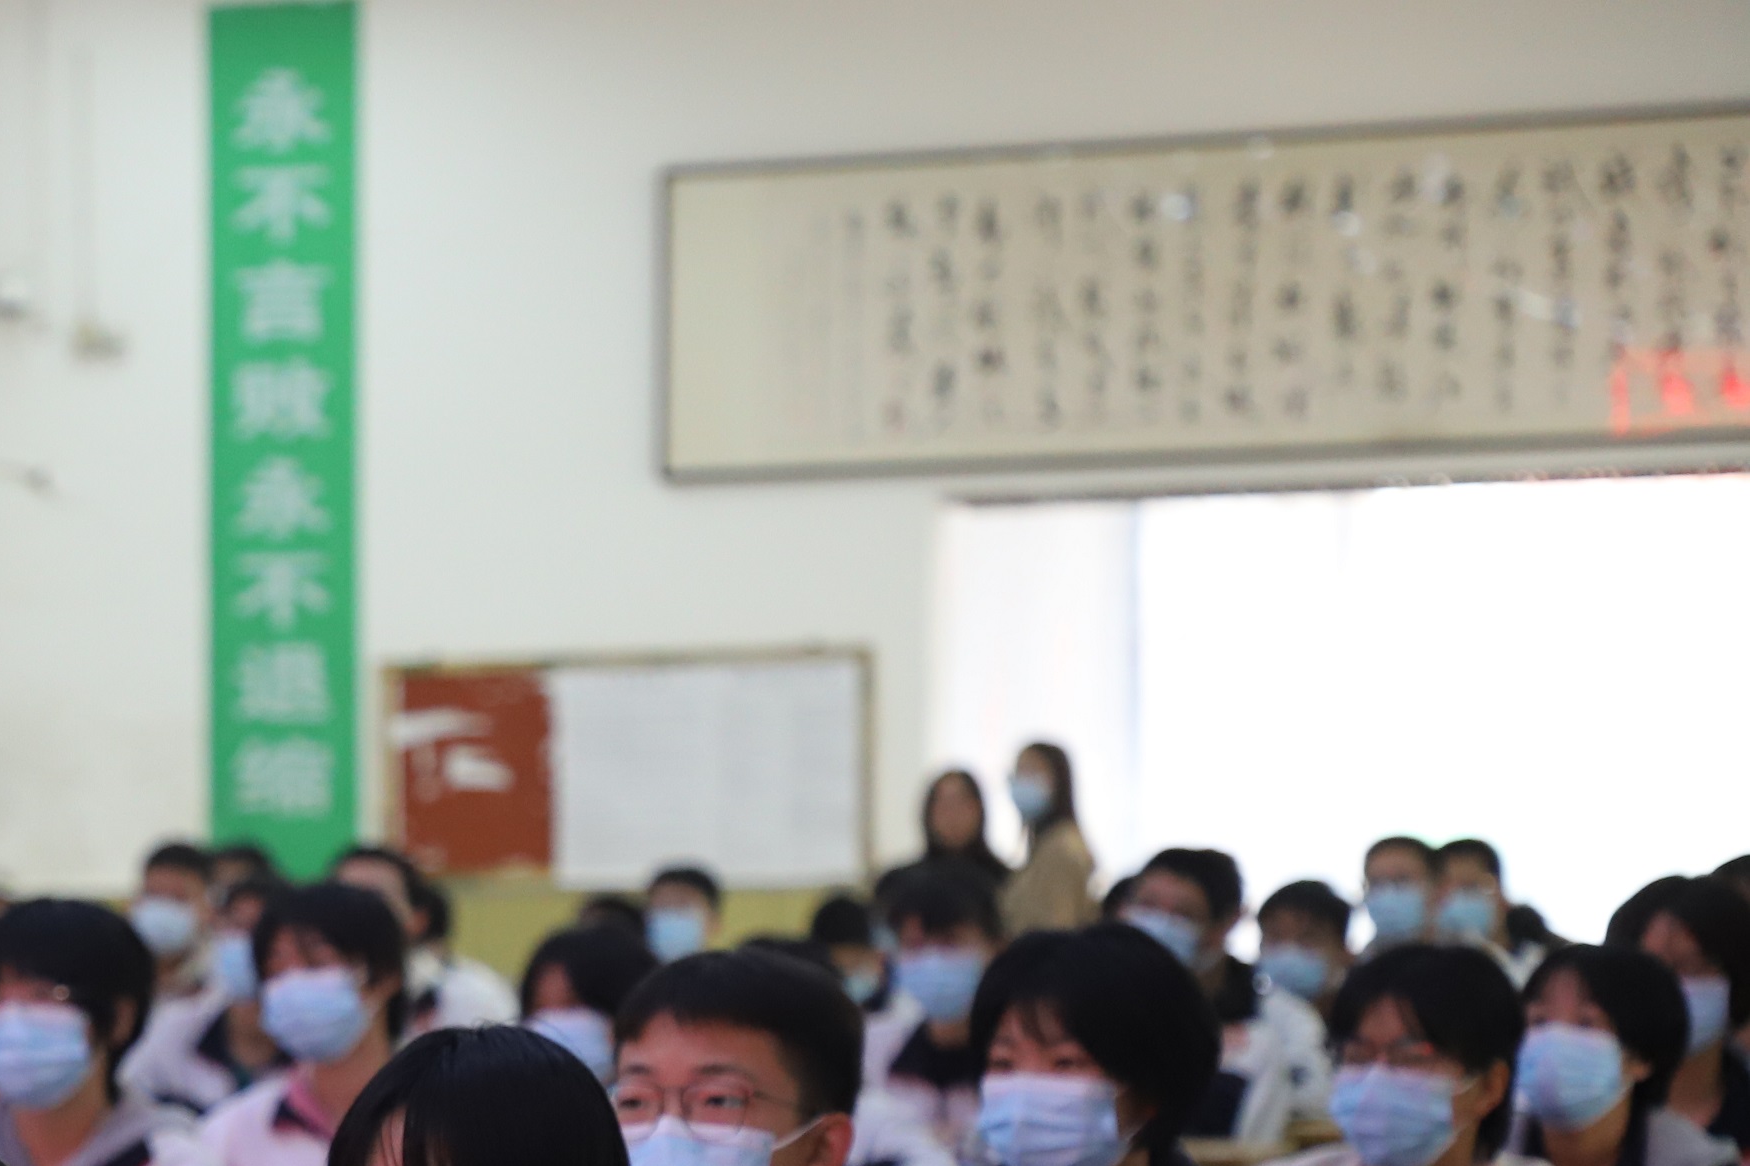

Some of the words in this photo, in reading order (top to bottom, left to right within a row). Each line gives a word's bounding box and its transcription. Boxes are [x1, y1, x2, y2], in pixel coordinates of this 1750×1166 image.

[231, 66, 334, 818] 永不言败永不退缩
